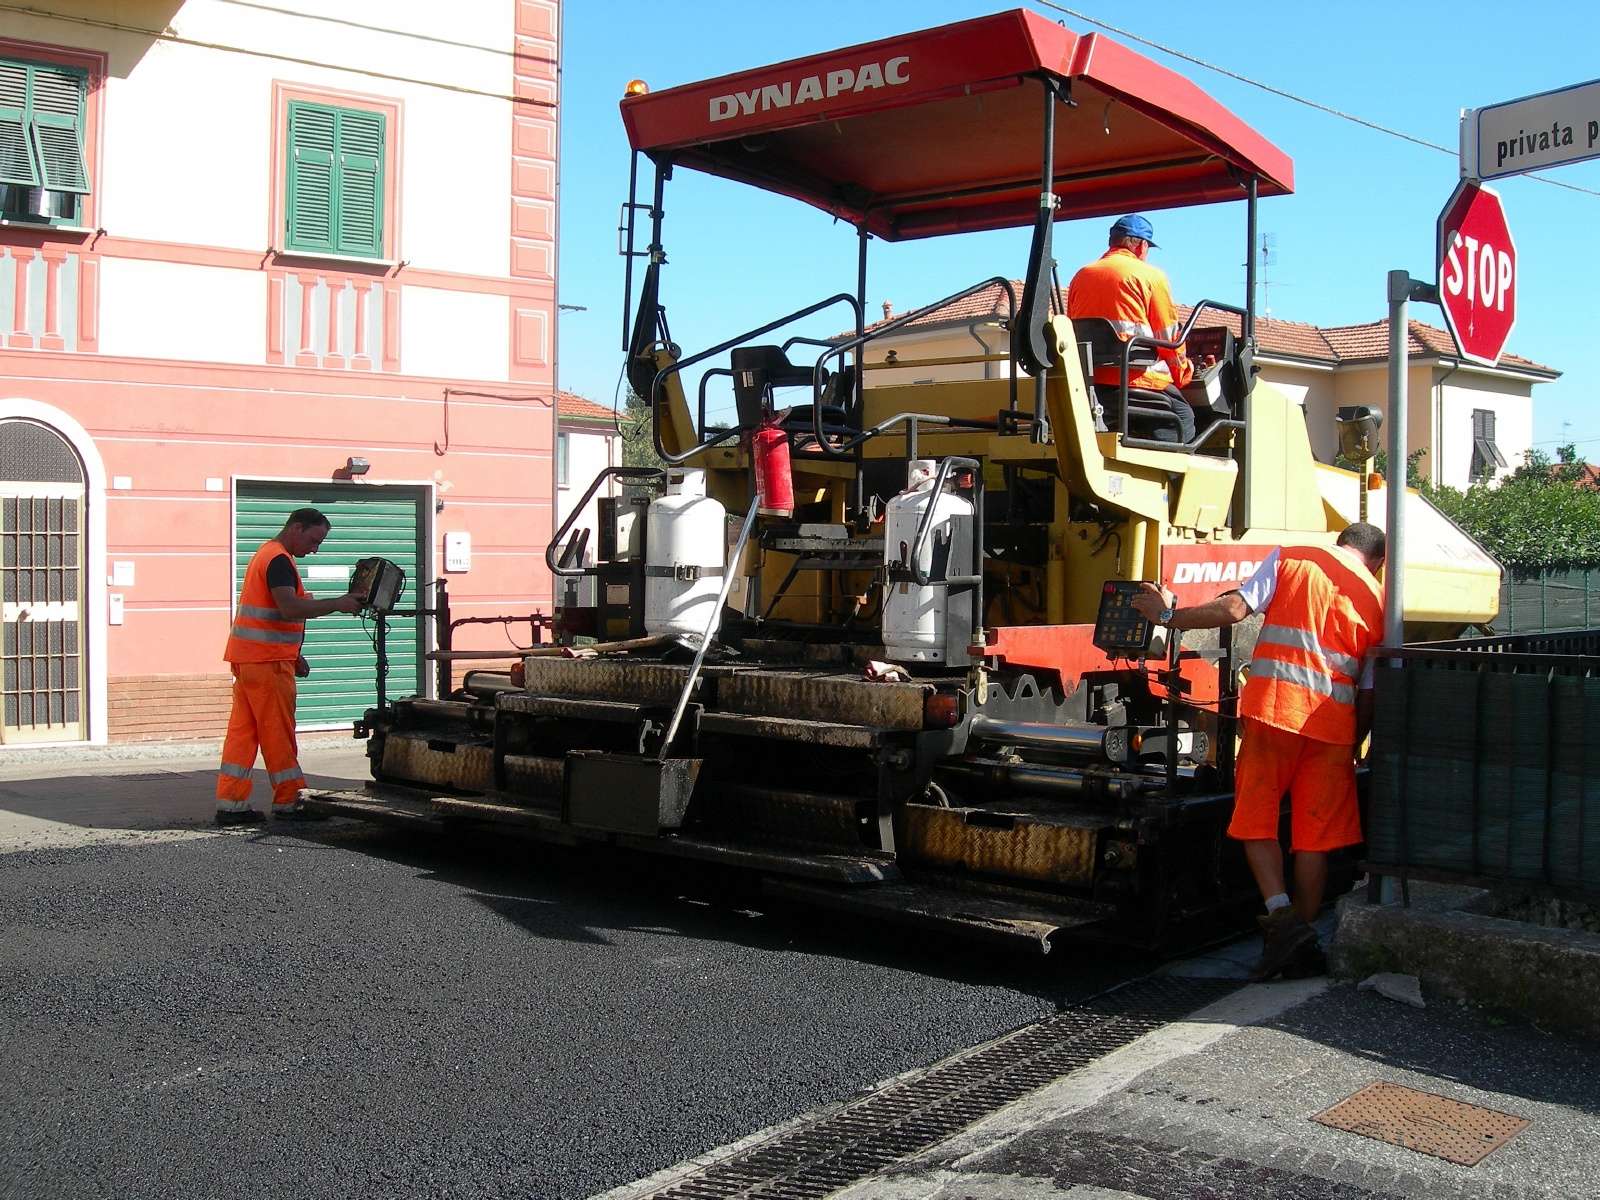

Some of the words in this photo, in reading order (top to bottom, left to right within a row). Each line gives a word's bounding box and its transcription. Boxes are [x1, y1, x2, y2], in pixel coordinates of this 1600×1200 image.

[709, 56, 910, 122] DYNAPAC
[1497, 121, 1574, 168] privata
[1587, 120, 1600, 149] p
[1447, 229, 1513, 312] STOP
